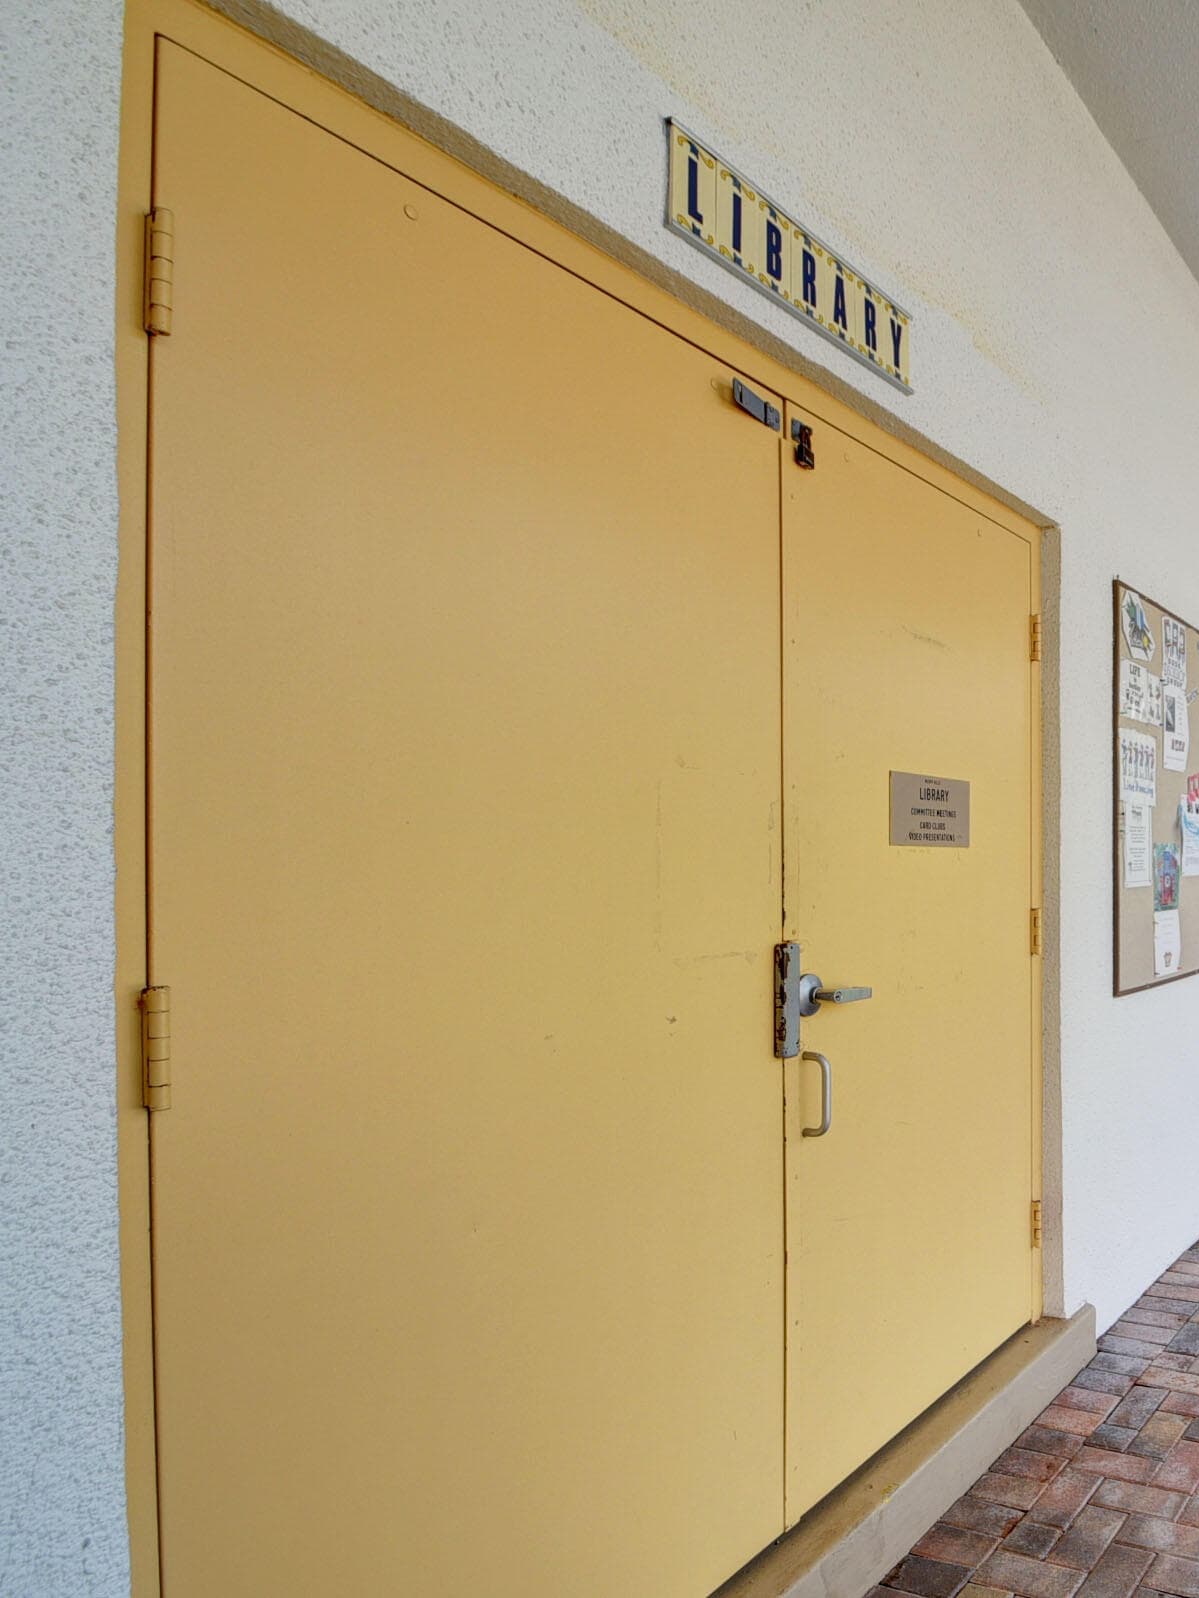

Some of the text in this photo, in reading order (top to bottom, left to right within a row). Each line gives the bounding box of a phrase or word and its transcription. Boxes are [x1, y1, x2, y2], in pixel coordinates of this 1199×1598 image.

[687, 155, 902, 369] LIBRARY
[919, 787, 950, 802] LIBRARY
[911, 808, 957, 818] COMMITTEE MEETINGS
[919, 821, 946, 831] CARD CLUBS
[908, 832, 922, 841] VIDEO
